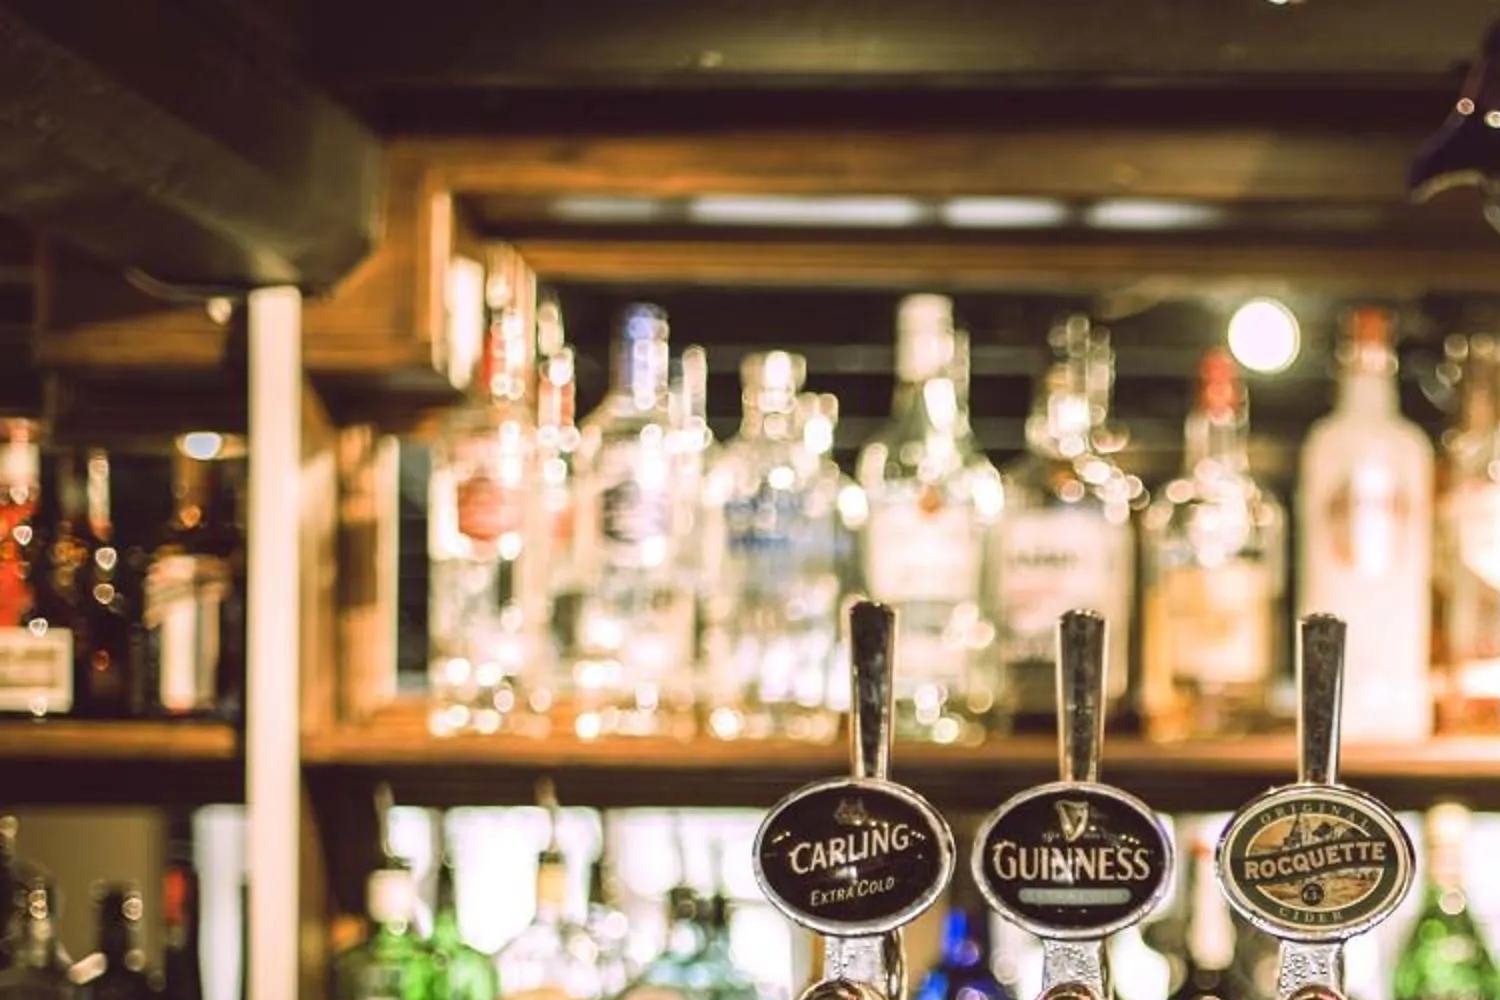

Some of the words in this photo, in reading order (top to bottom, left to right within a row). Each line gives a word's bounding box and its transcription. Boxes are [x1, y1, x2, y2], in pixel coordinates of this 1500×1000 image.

[1260, 802, 1371, 835] ORIGINAL
[788, 823, 909, 875] CARLING
[991, 840, 1151, 881] GUINNESS
[1244, 840, 1387, 880] ROCQUETTE
[857, 876, 896, 897] COLD
[1278, 907, 1343, 923] CIDER
